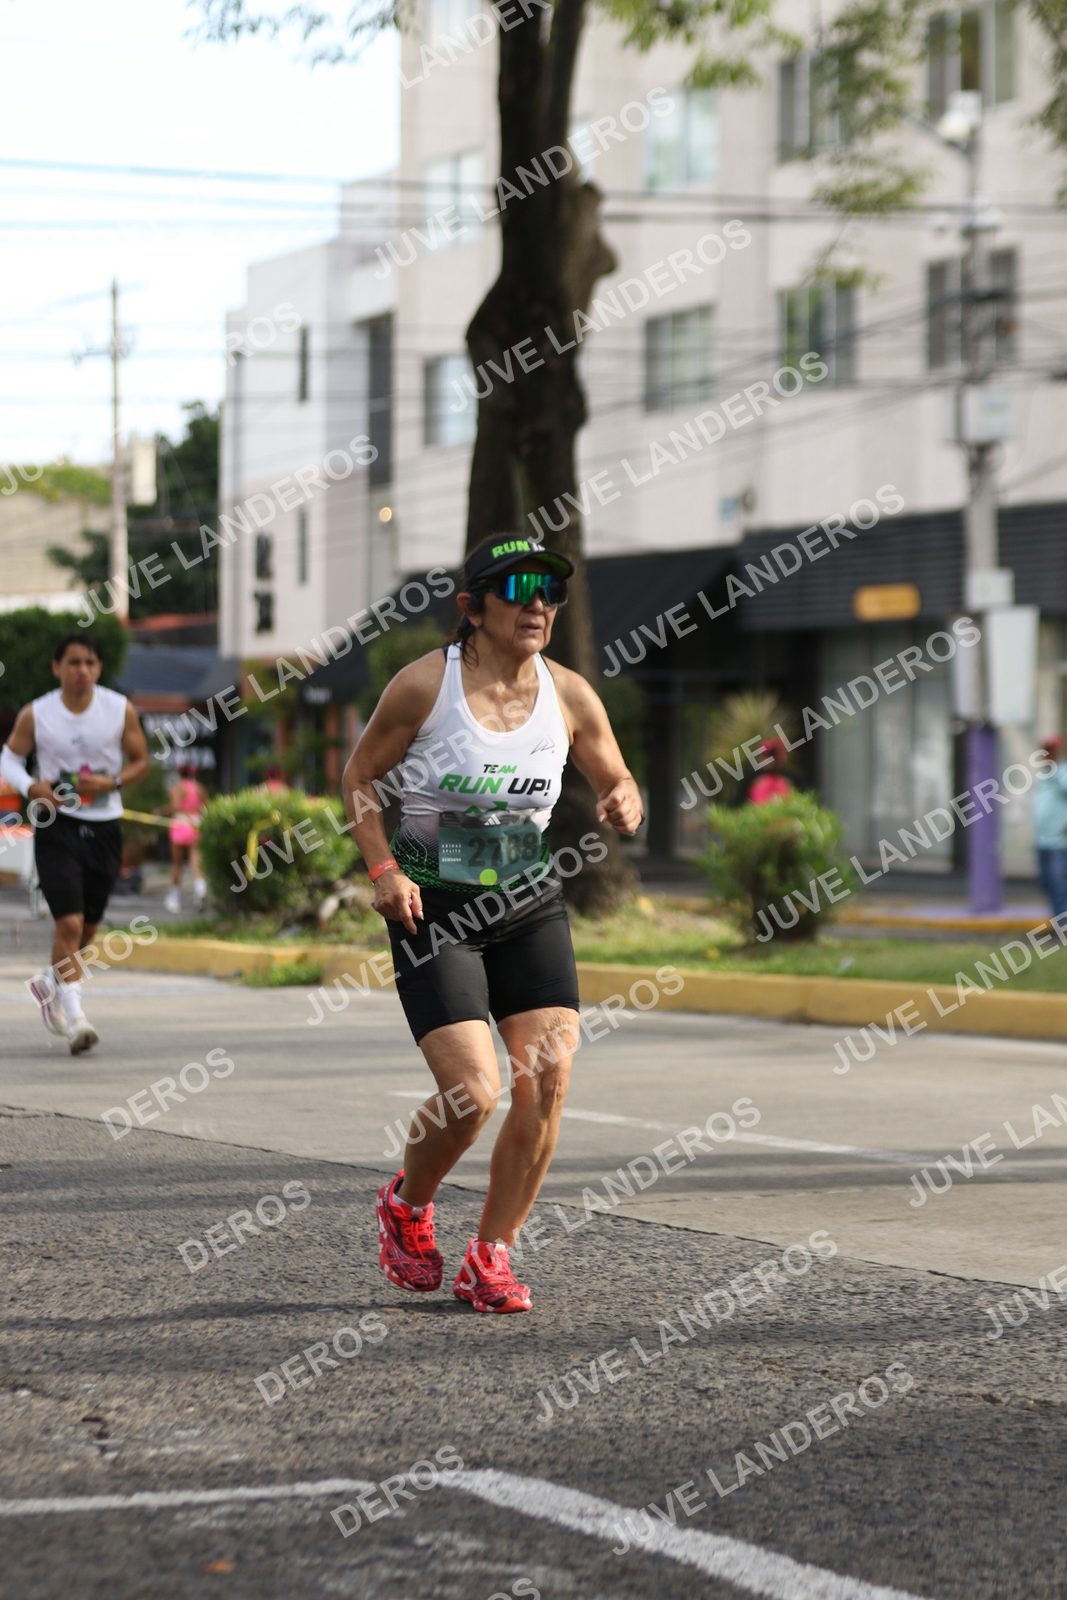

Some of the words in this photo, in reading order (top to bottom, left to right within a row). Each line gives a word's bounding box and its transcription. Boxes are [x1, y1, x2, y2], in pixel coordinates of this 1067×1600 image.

[492, 540, 531, 559] RUN
[483, 764, 517, 774] TEAM
[438, 774, 504, 794] RUN
[508, 778, 553, 796] UP!
